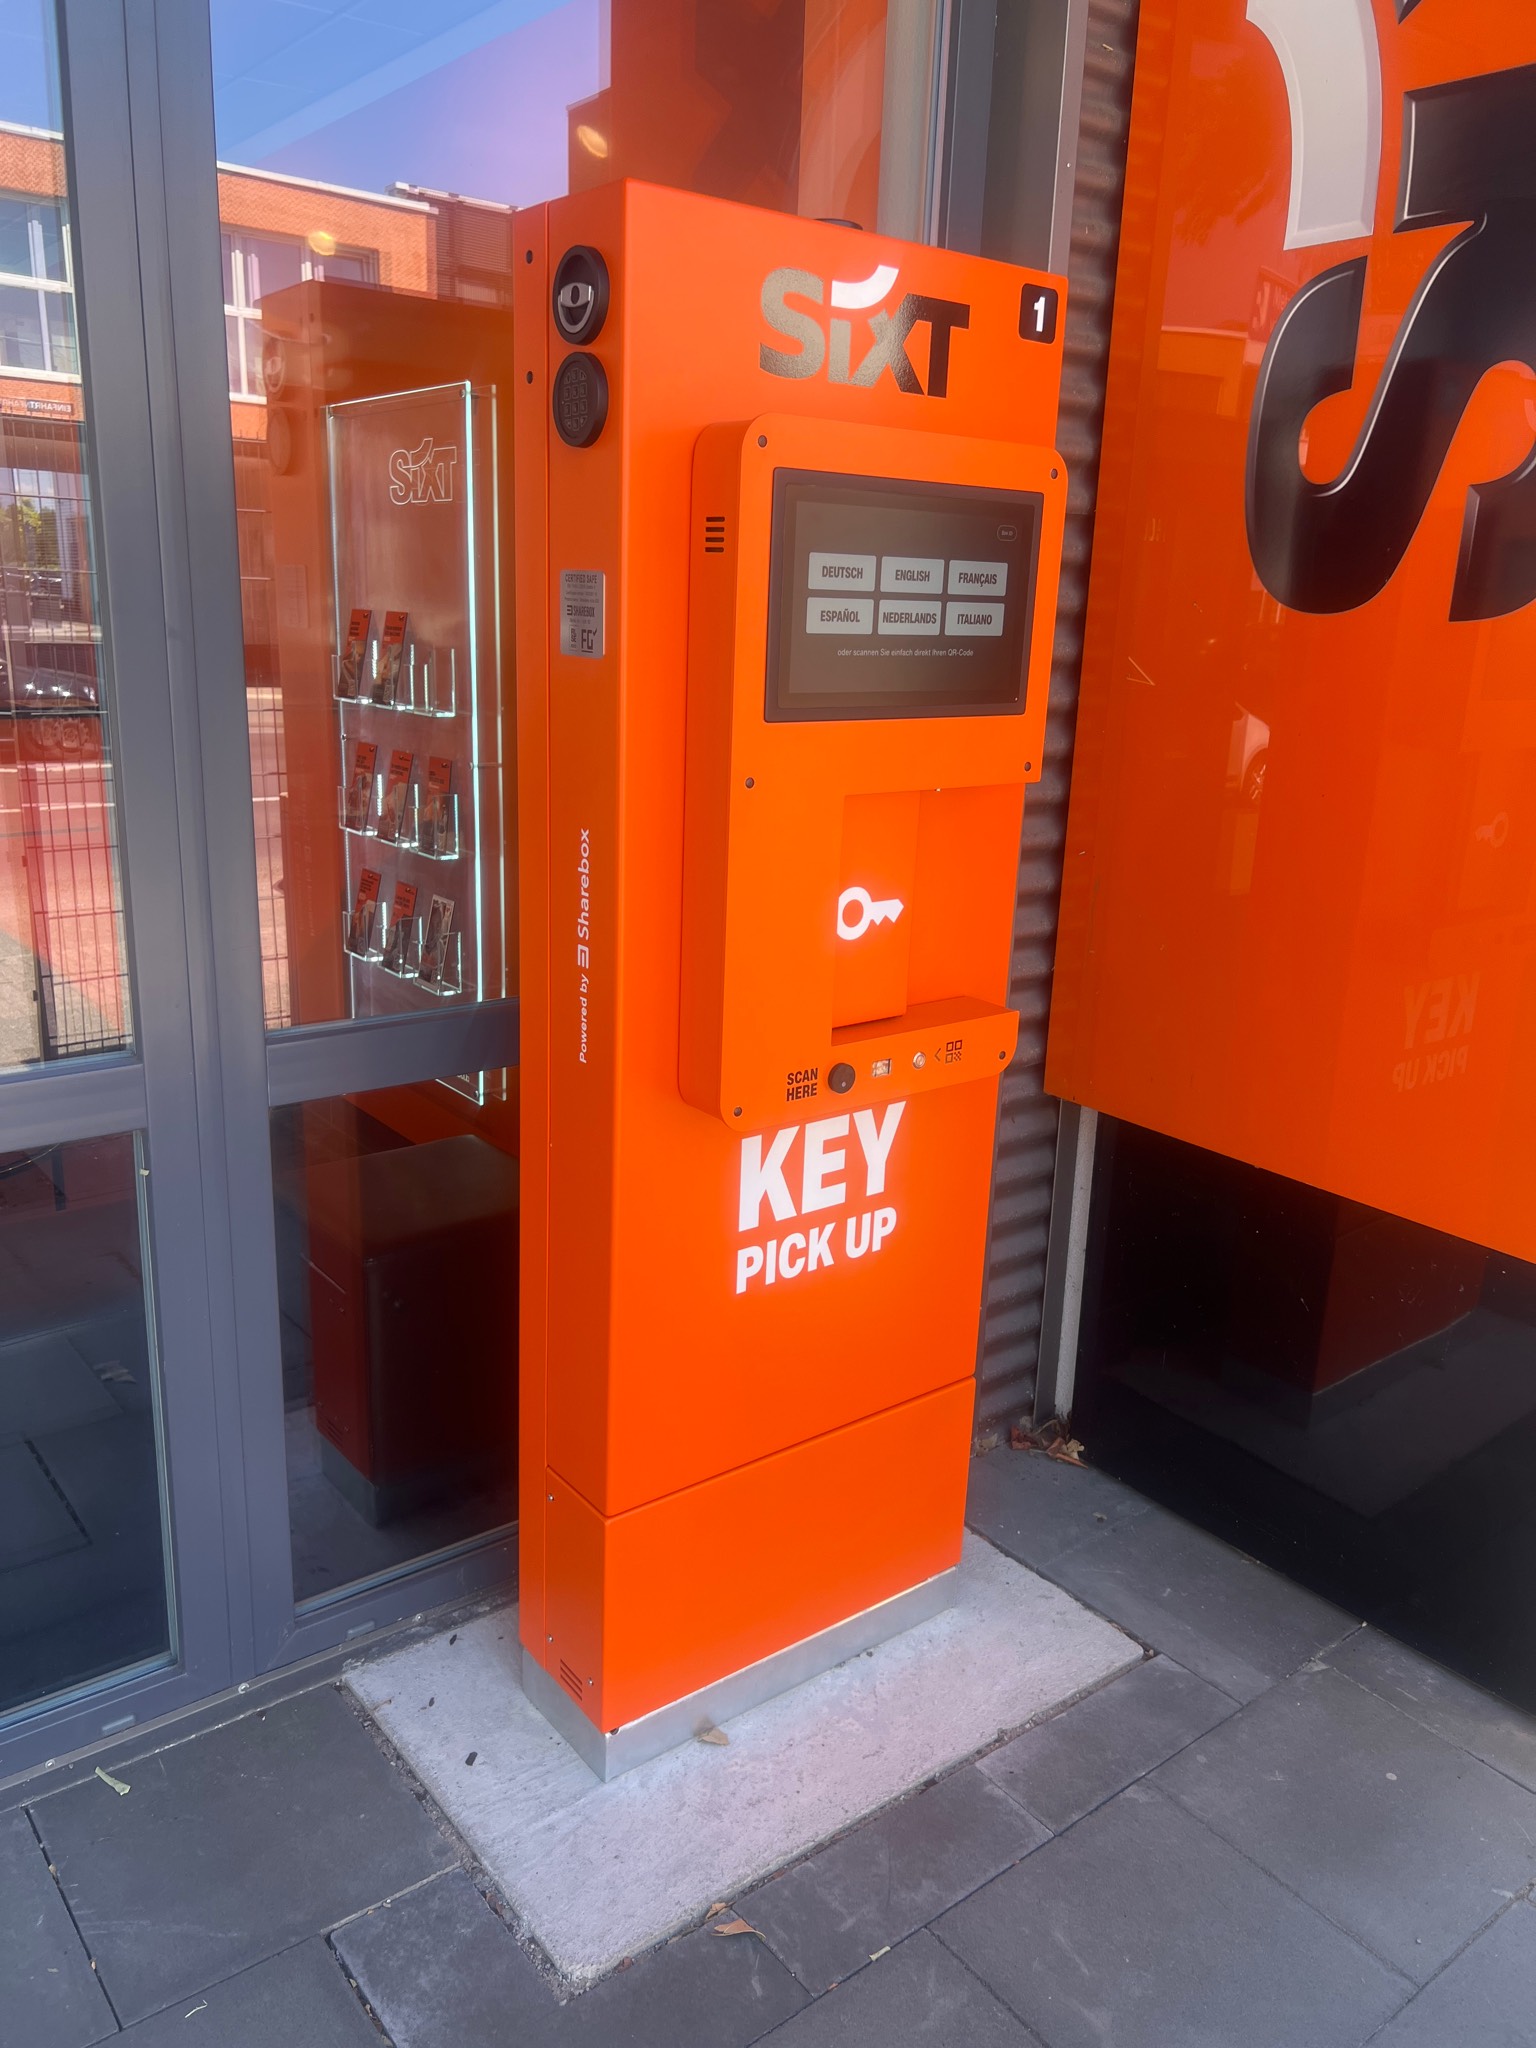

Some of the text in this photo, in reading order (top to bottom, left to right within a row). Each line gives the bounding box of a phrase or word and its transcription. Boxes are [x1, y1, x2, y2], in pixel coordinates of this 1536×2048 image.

[1033, 296, 1046, 333] 1
[565, 574, 597, 584] CERTIFIED SAFE
[822, 566, 863, 579] DEUTSCH
[895, 570, 930, 582] ENGLISH
[958, 572, 997, 587] FRANÇAIS
[574, 606, 595, 617] SHAREBOX
[820, 609, 860, 622] ESPAÑOL
[882, 611, 937, 625] NEDERLANDS
[957, 613, 993, 626] ITALIANO
[581, 629, 593, 650] FG
[837, 649, 852, 657] oder
[853, 649, 879, 657] scannen
[880, 648, 890, 657] Sie
[891, 649, 913, 657] einfach
[914, 649, 931, 657] direkt
[948, 649, 974, 658] QR-Code
[578, 828, 590, 941] Sharebox
[580, 973, 589, 993] by
[787, 1068, 818, 1086] SCAN
[786, 1083, 818, 1102] HERE
[739, 1101, 906, 1232] KEY
[736, 1206, 898, 1294] PICK UP
